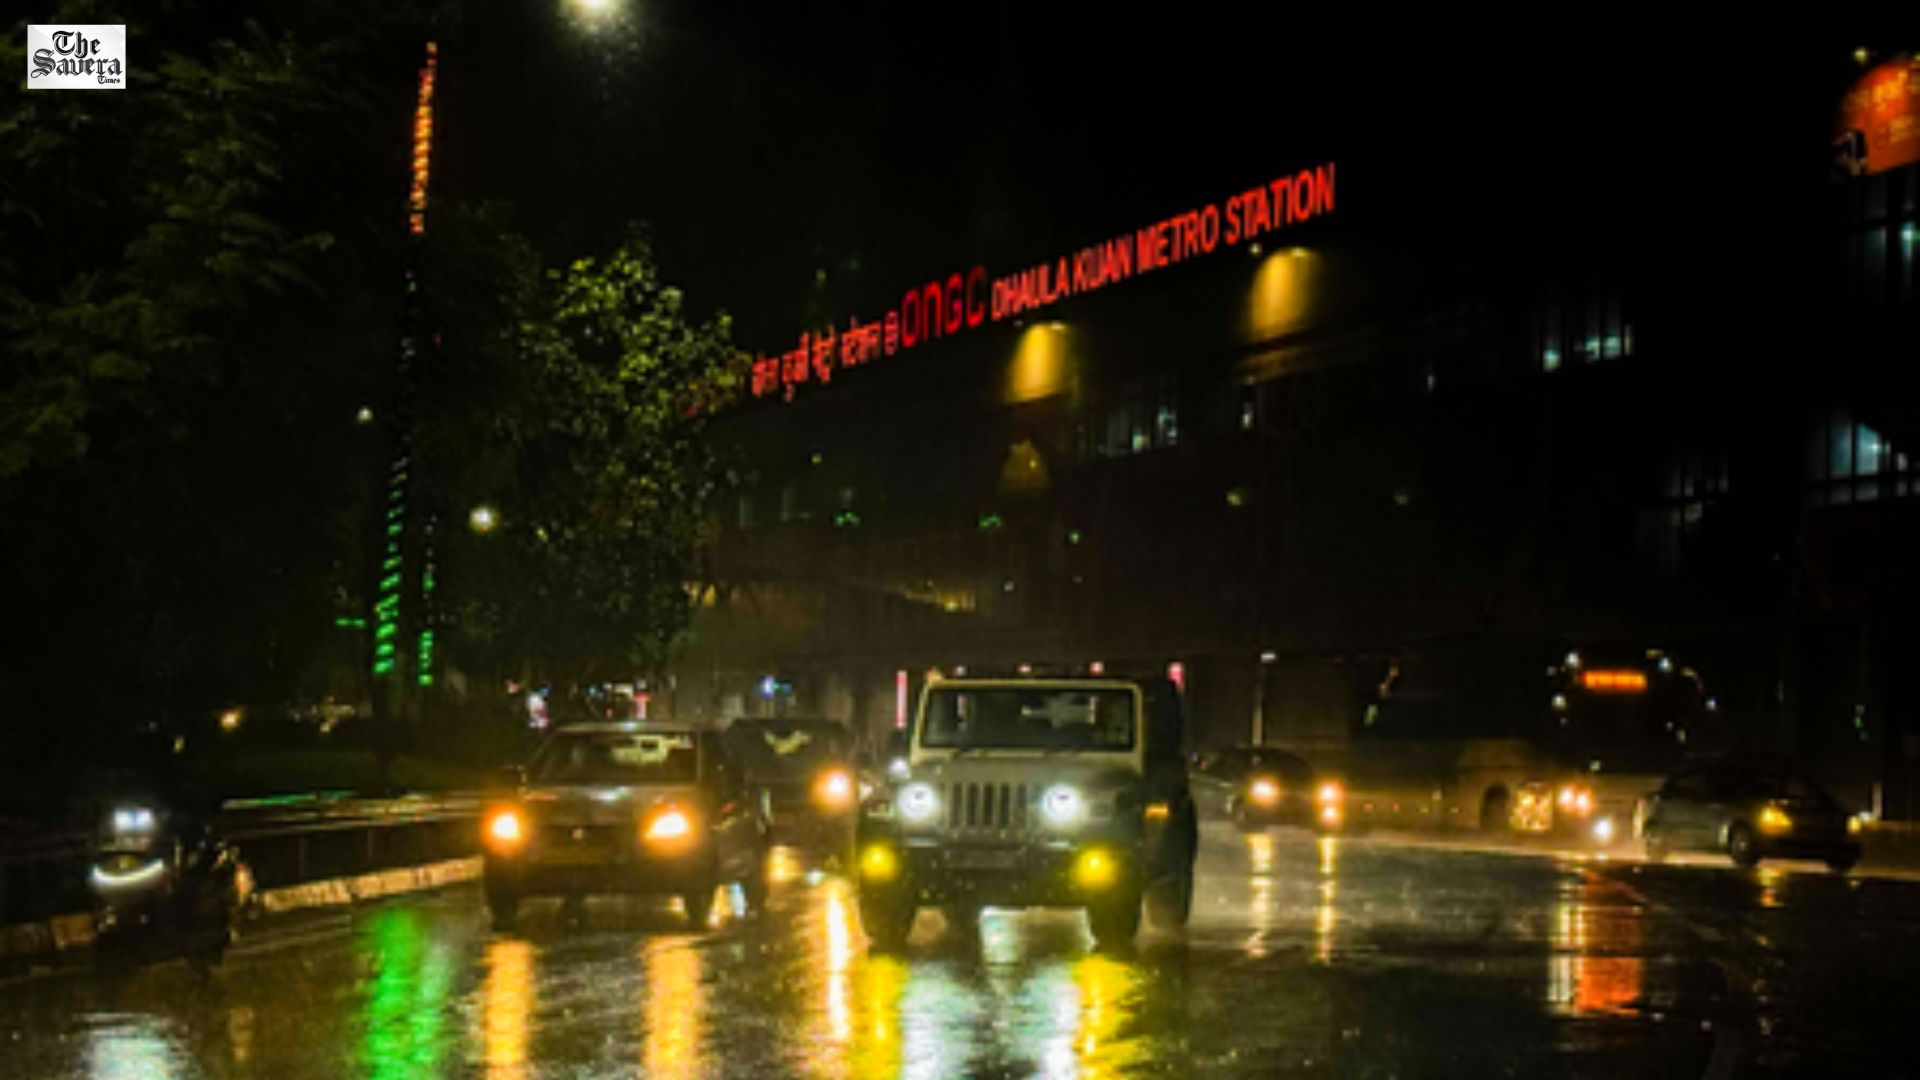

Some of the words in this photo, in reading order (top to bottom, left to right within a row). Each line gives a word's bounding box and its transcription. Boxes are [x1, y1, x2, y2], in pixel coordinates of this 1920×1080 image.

[902, 264, 986, 348] ONGC
[991, 255, 1070, 322] DHAULA
[1072, 234, 1134, 295] KUAN
[1136, 203, 1220, 276] METRO
[1224, 161, 1336, 246] STATION
